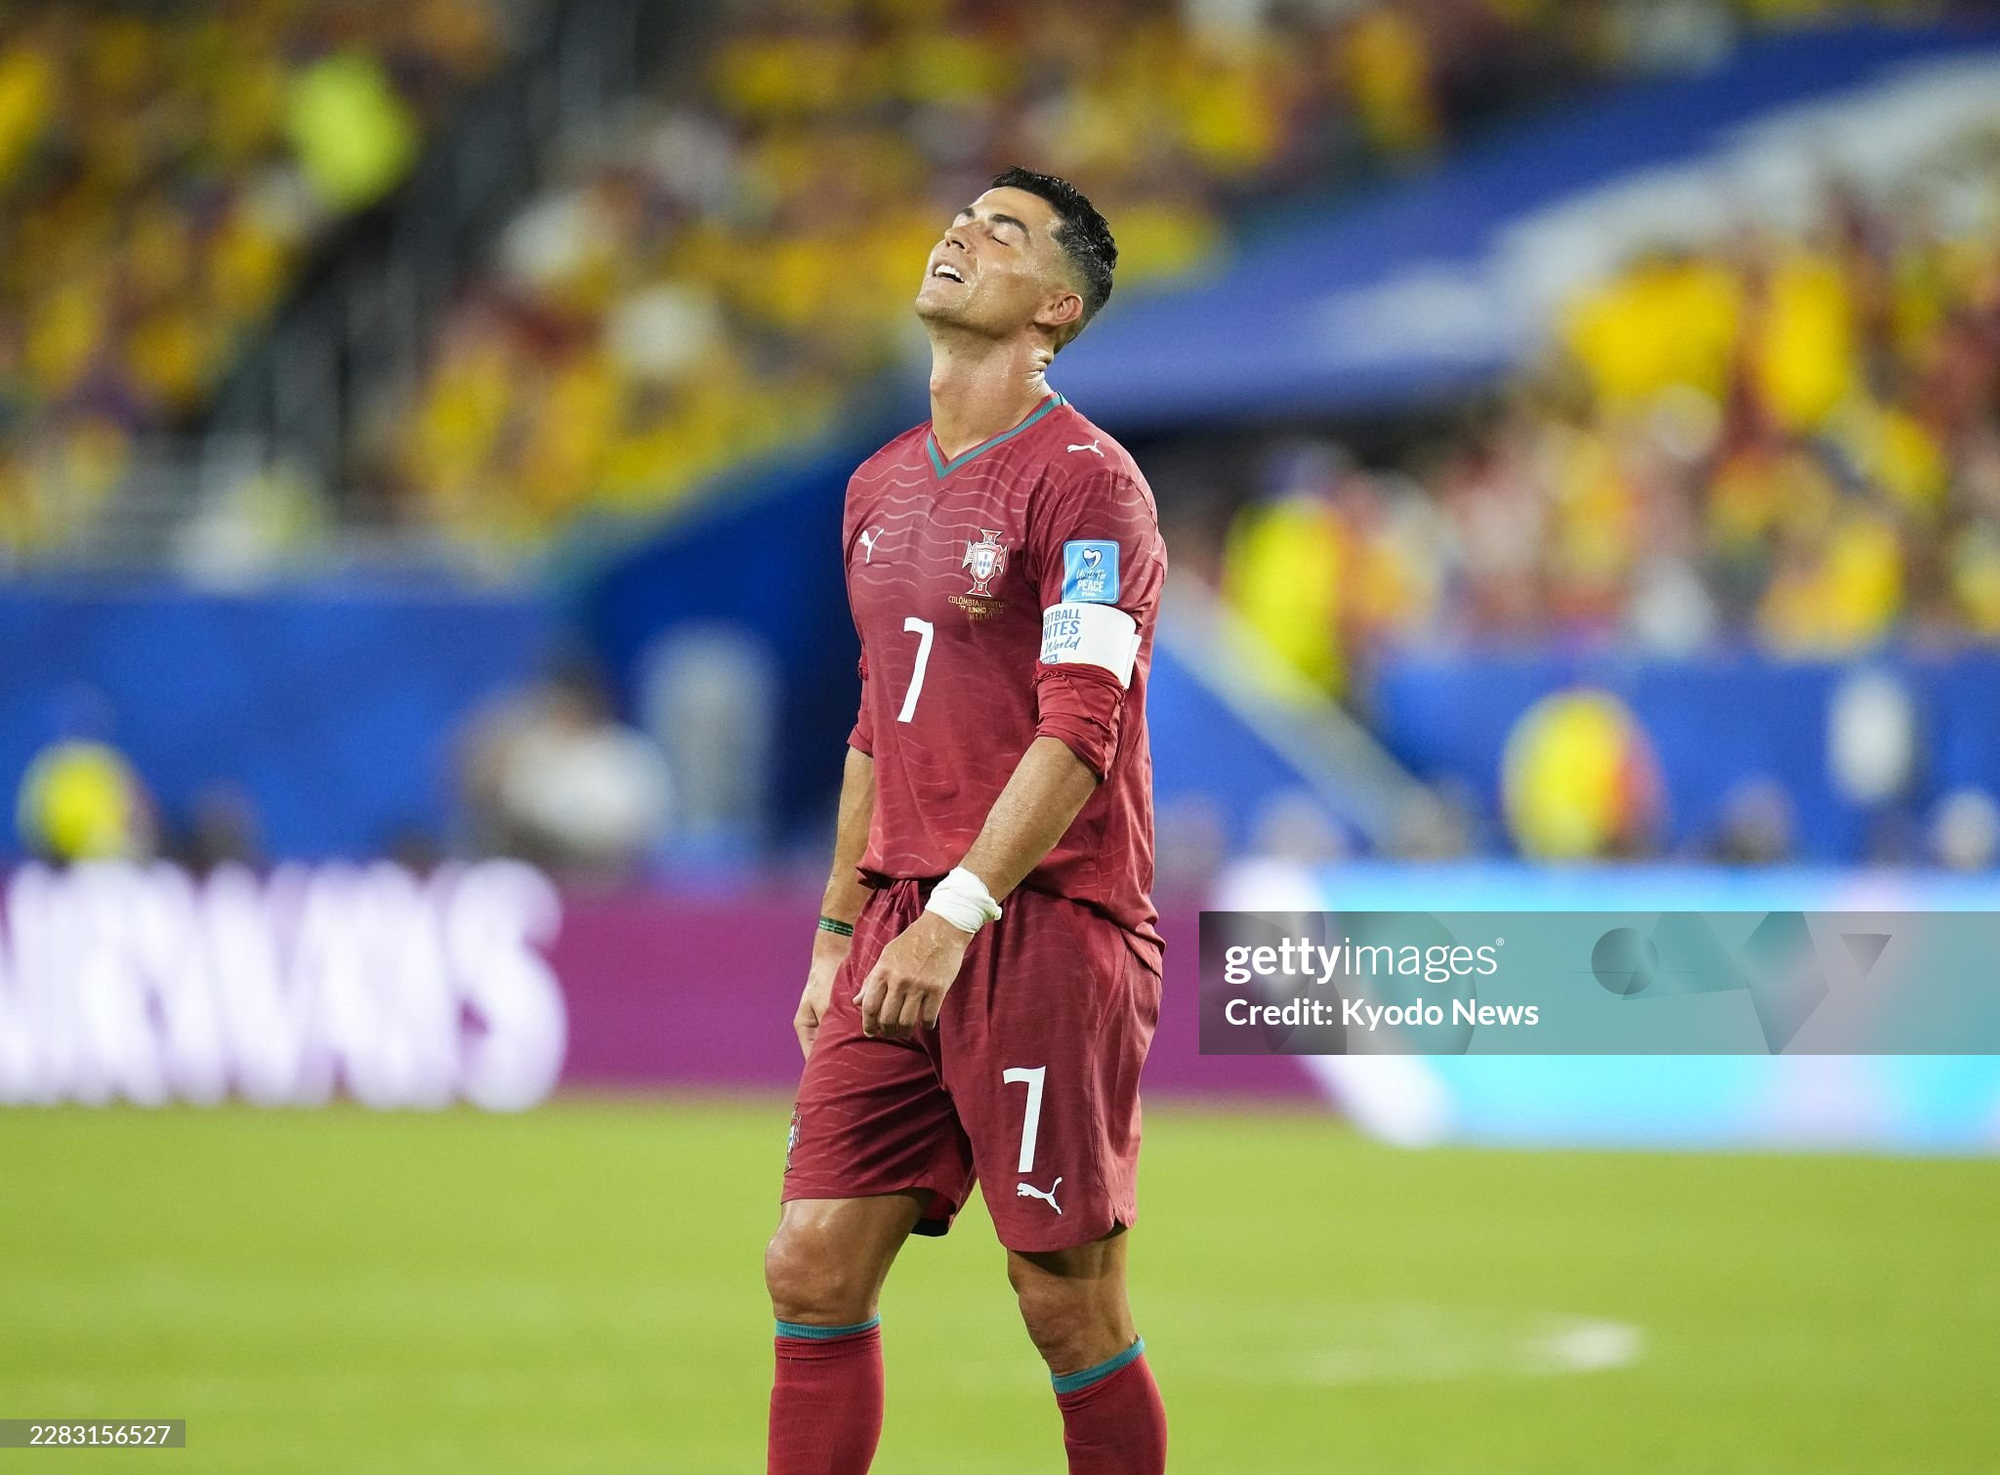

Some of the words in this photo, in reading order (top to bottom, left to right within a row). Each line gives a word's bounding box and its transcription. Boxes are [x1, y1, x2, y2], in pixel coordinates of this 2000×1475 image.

[1077, 579, 1105, 593] PEACE
[1044, 608, 1082, 626] OTBALL
[1043, 619, 1081, 641] NITES
[1044, 635, 1082, 654] World
[896, 616, 934, 723] 7
[1002, 1065, 1047, 1173] 7
